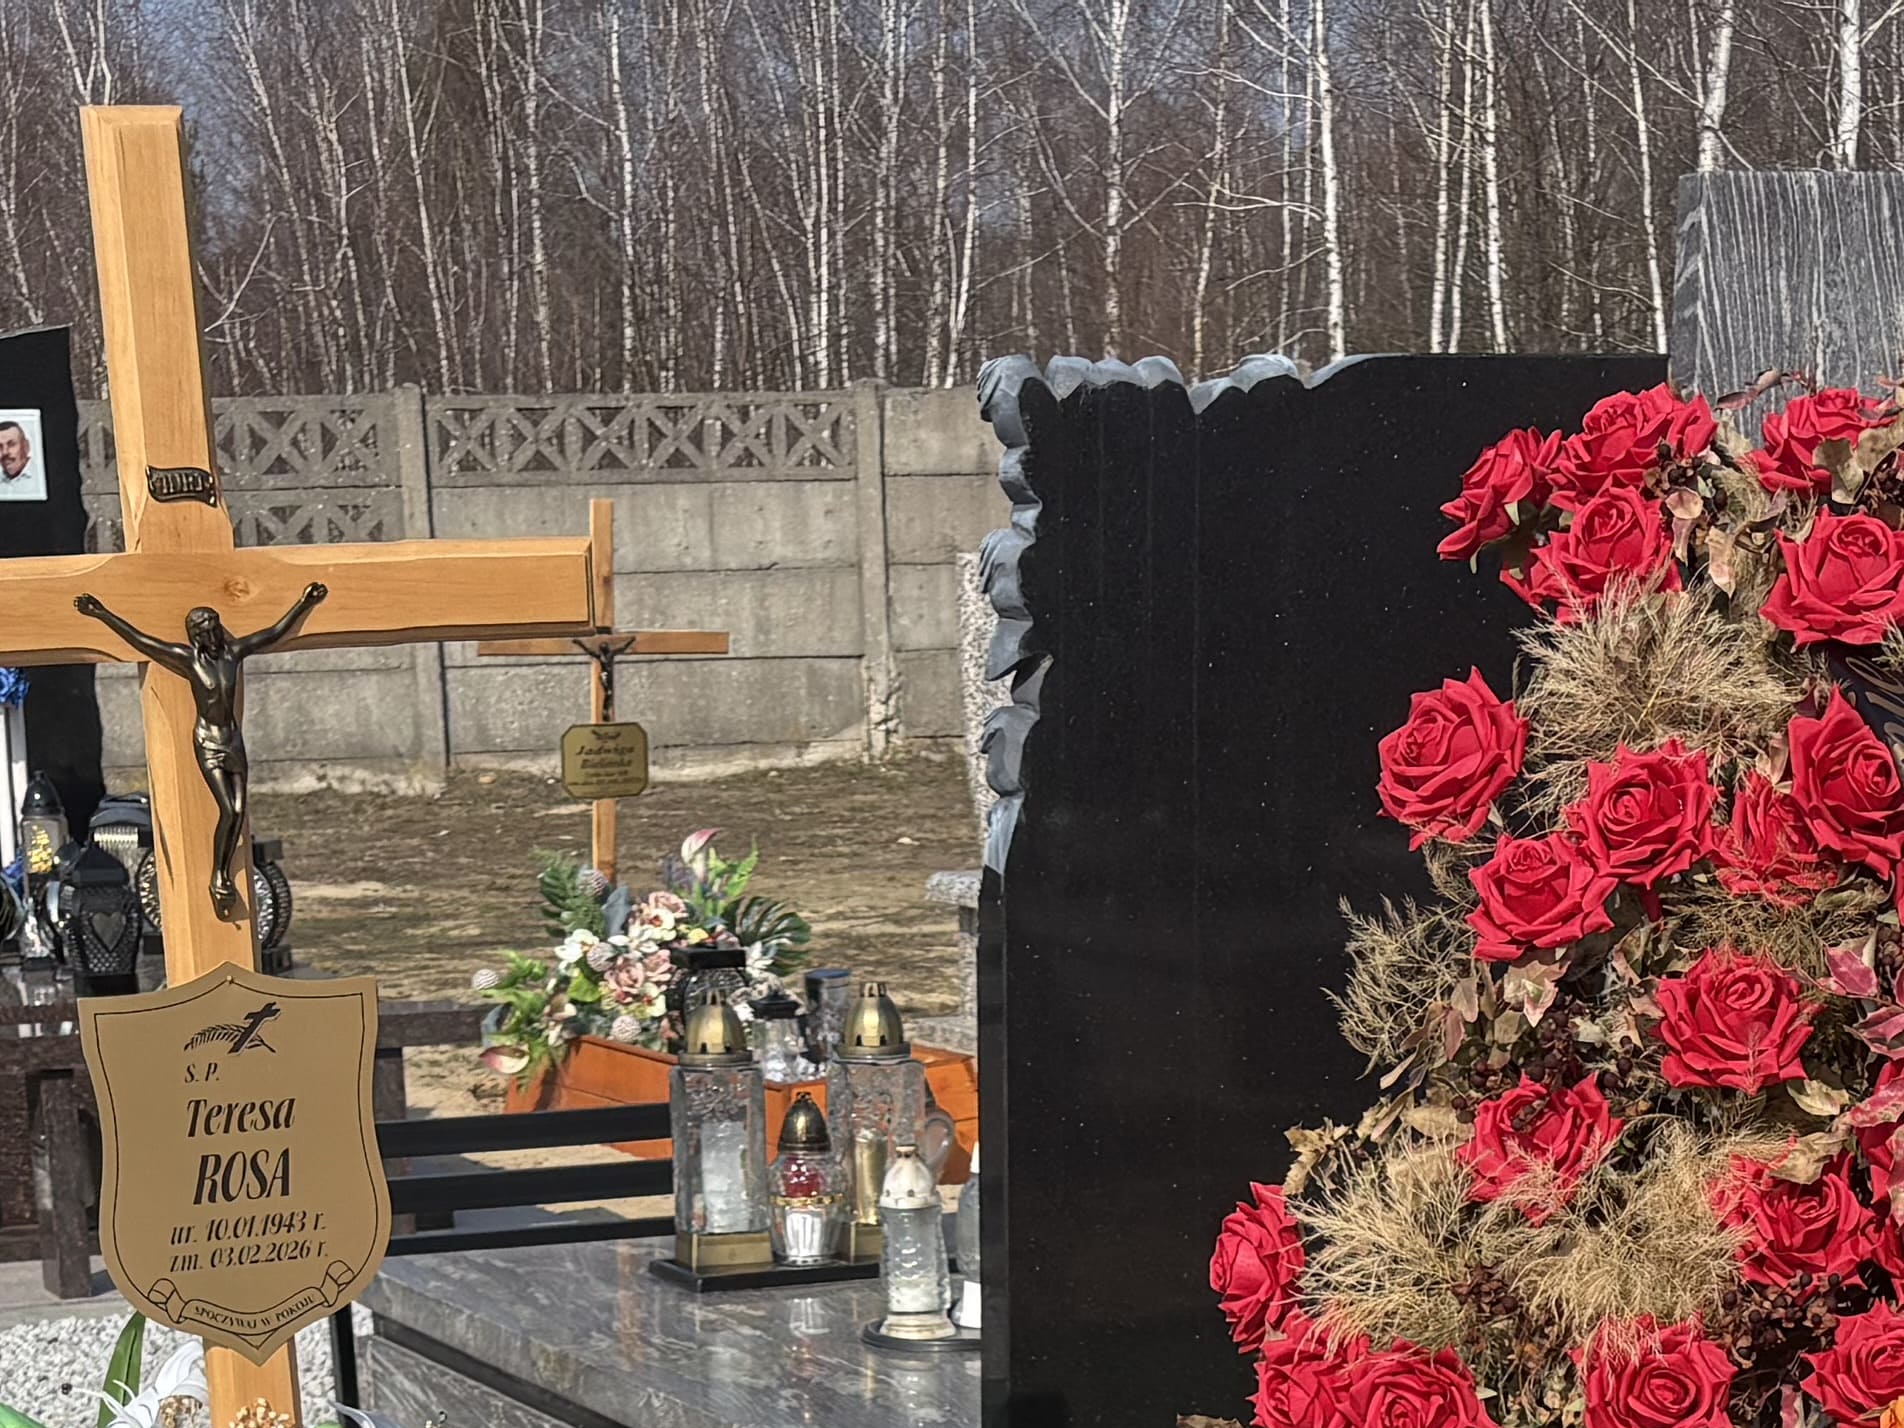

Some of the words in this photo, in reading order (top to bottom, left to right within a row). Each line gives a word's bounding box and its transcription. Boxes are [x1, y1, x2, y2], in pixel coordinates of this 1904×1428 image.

[186, 1097, 296, 1138] Teresa
[193, 1147, 291, 1206] ROSA
[170, 1226, 197, 1246] ur.
[206, 1209, 308, 1243] 10.01.1943
[312, 1212, 327, 1231] r.
[169, 1253, 203, 1273] zm.
[210, 1239, 313, 1269] 03.02.2026
